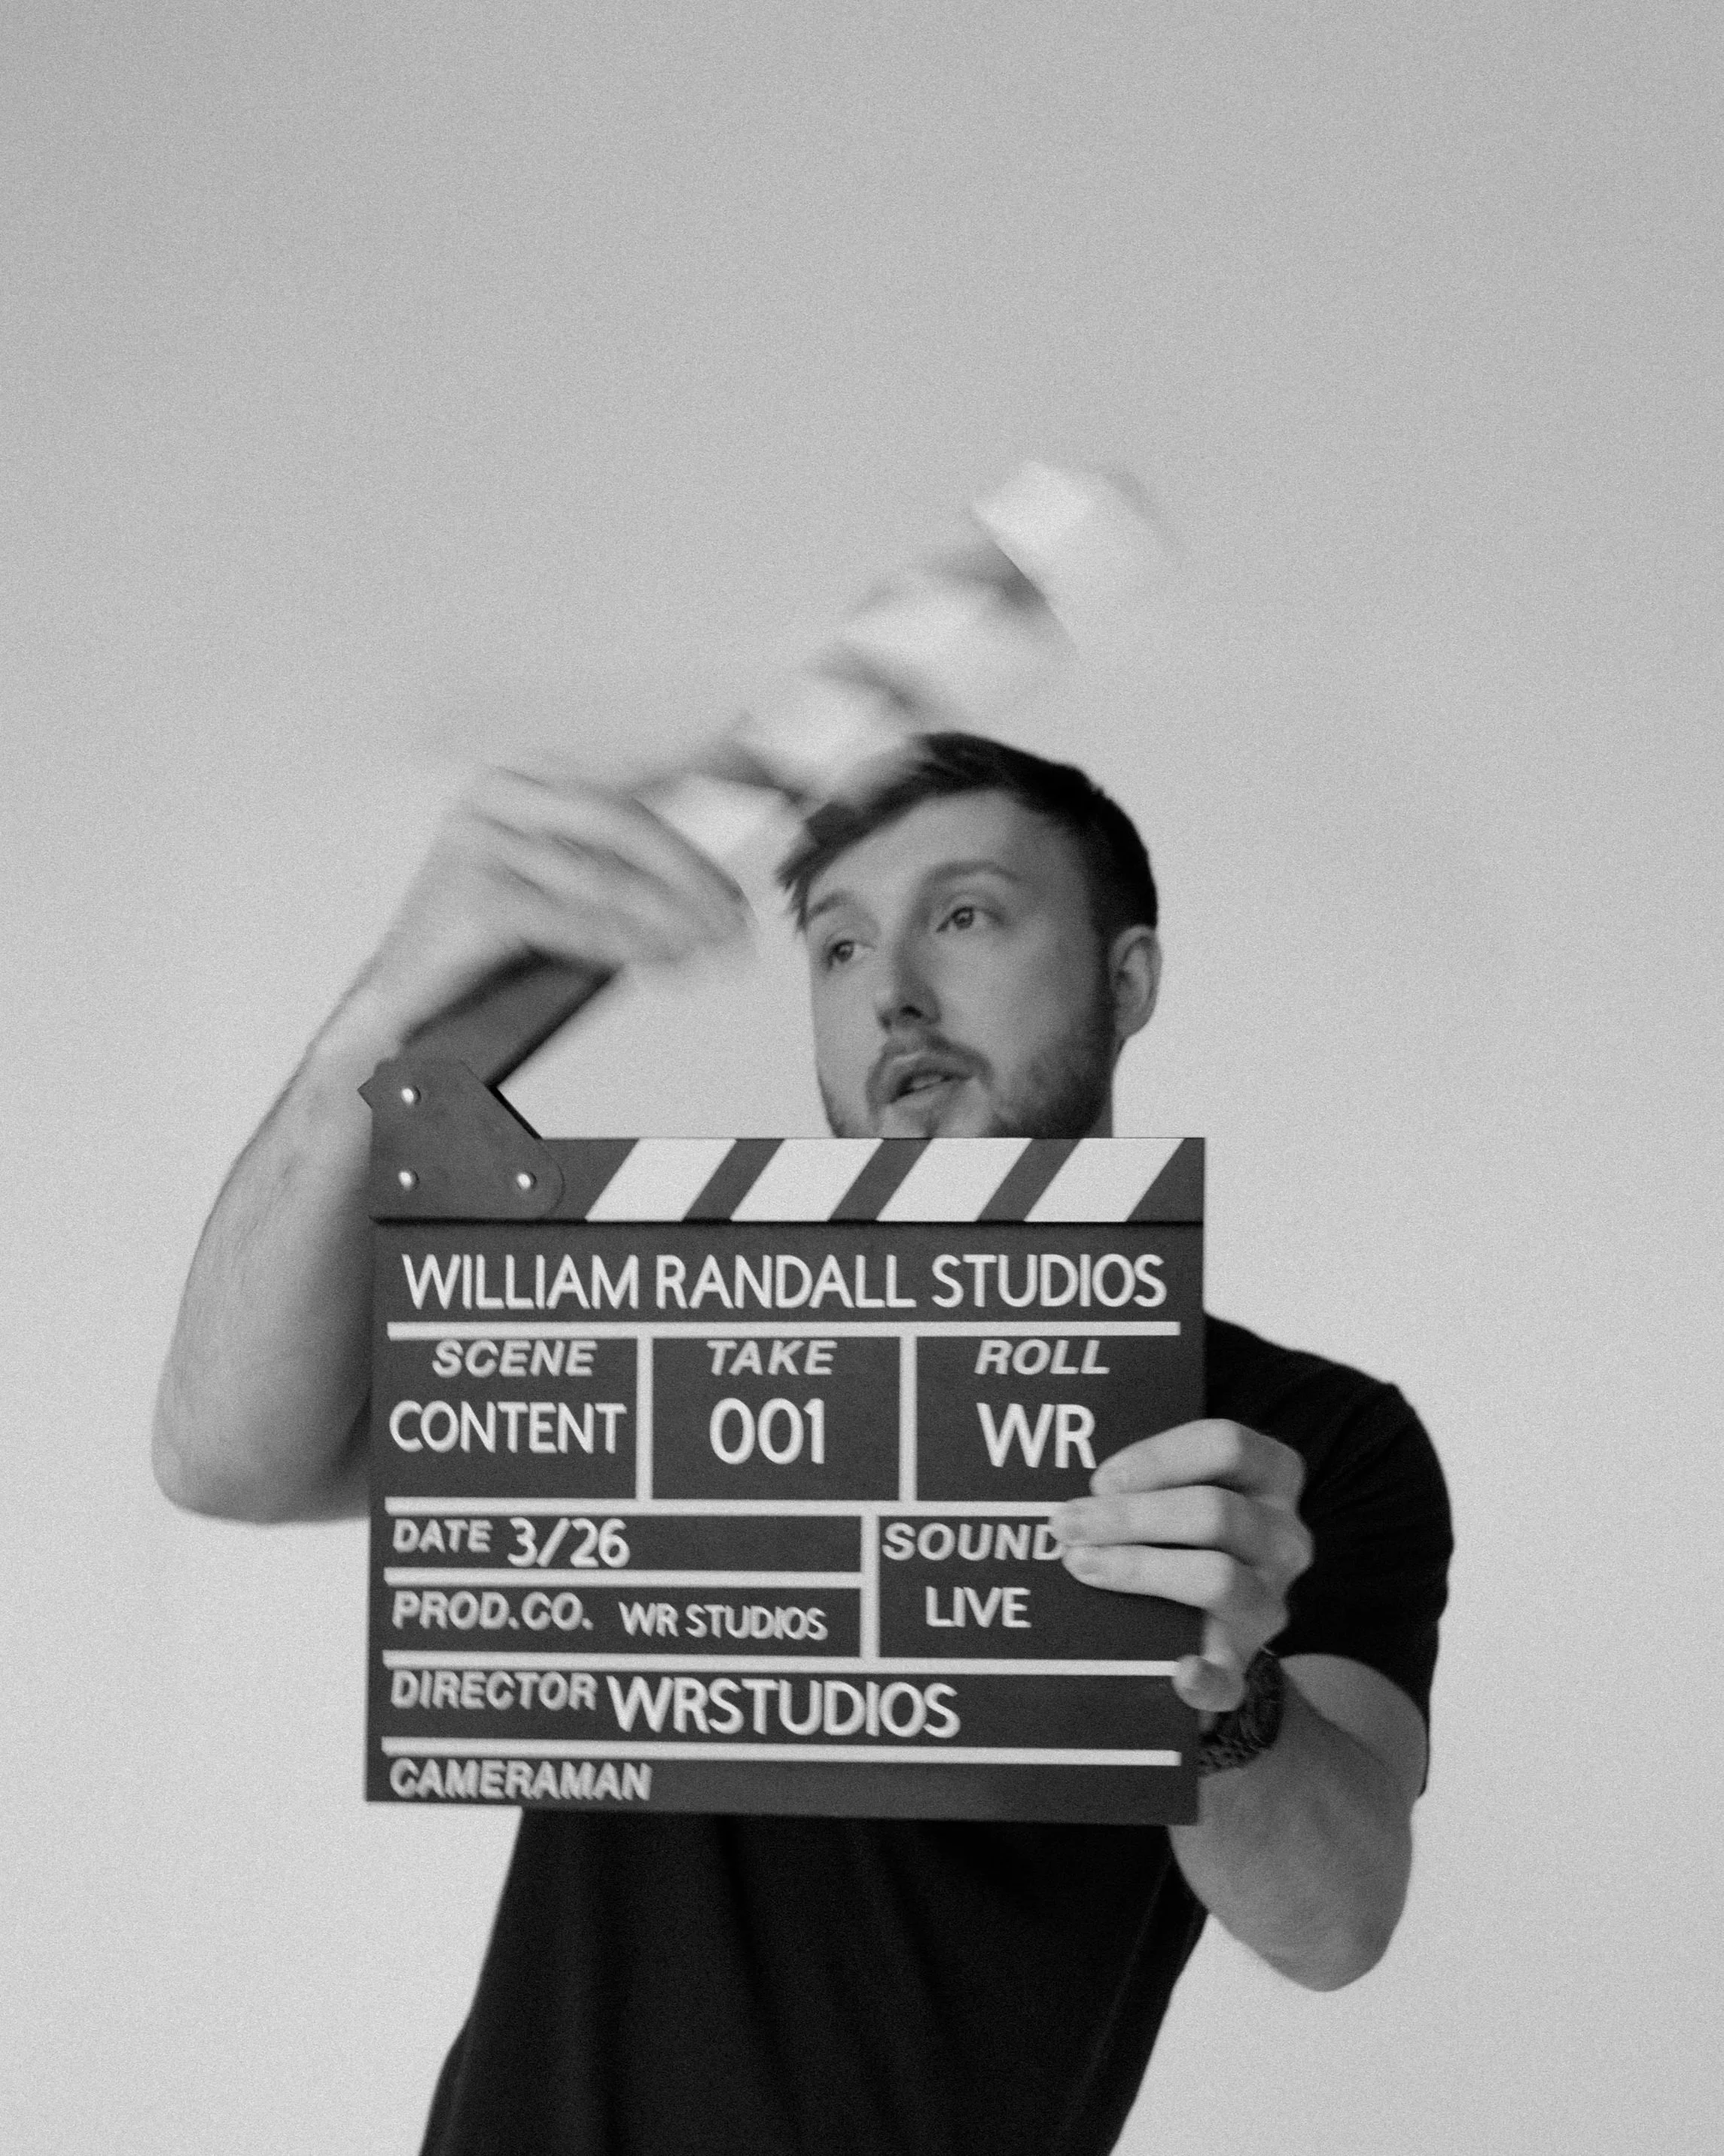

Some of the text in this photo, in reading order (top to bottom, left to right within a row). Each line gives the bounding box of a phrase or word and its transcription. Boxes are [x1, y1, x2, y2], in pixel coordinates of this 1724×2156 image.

[401, 1253, 1168, 1310] WILLIAM RANDALL STUDIOS
[431, 1339, 598, 1377] SCENE
[706, 1340, 837, 1376] TAKE
[974, 1339, 1110, 1375] ROLL
[389, 1400, 627, 1454] CONTENT
[709, 1397, 825, 1465] 001
[976, 1402, 1097, 1469] WR
[392, 1517, 631, 1568] DATE 3/26
[882, 1522, 1062, 1561] SOUND
[617, 1602, 679, 1637] WR
[686, 1604, 828, 1642] STUDIOS
[925, 1586, 1032, 1629] LIVE
[390, 1669, 599, 1710] DIRECTOR
[389, 1758, 653, 1801] CAMERAMAN
